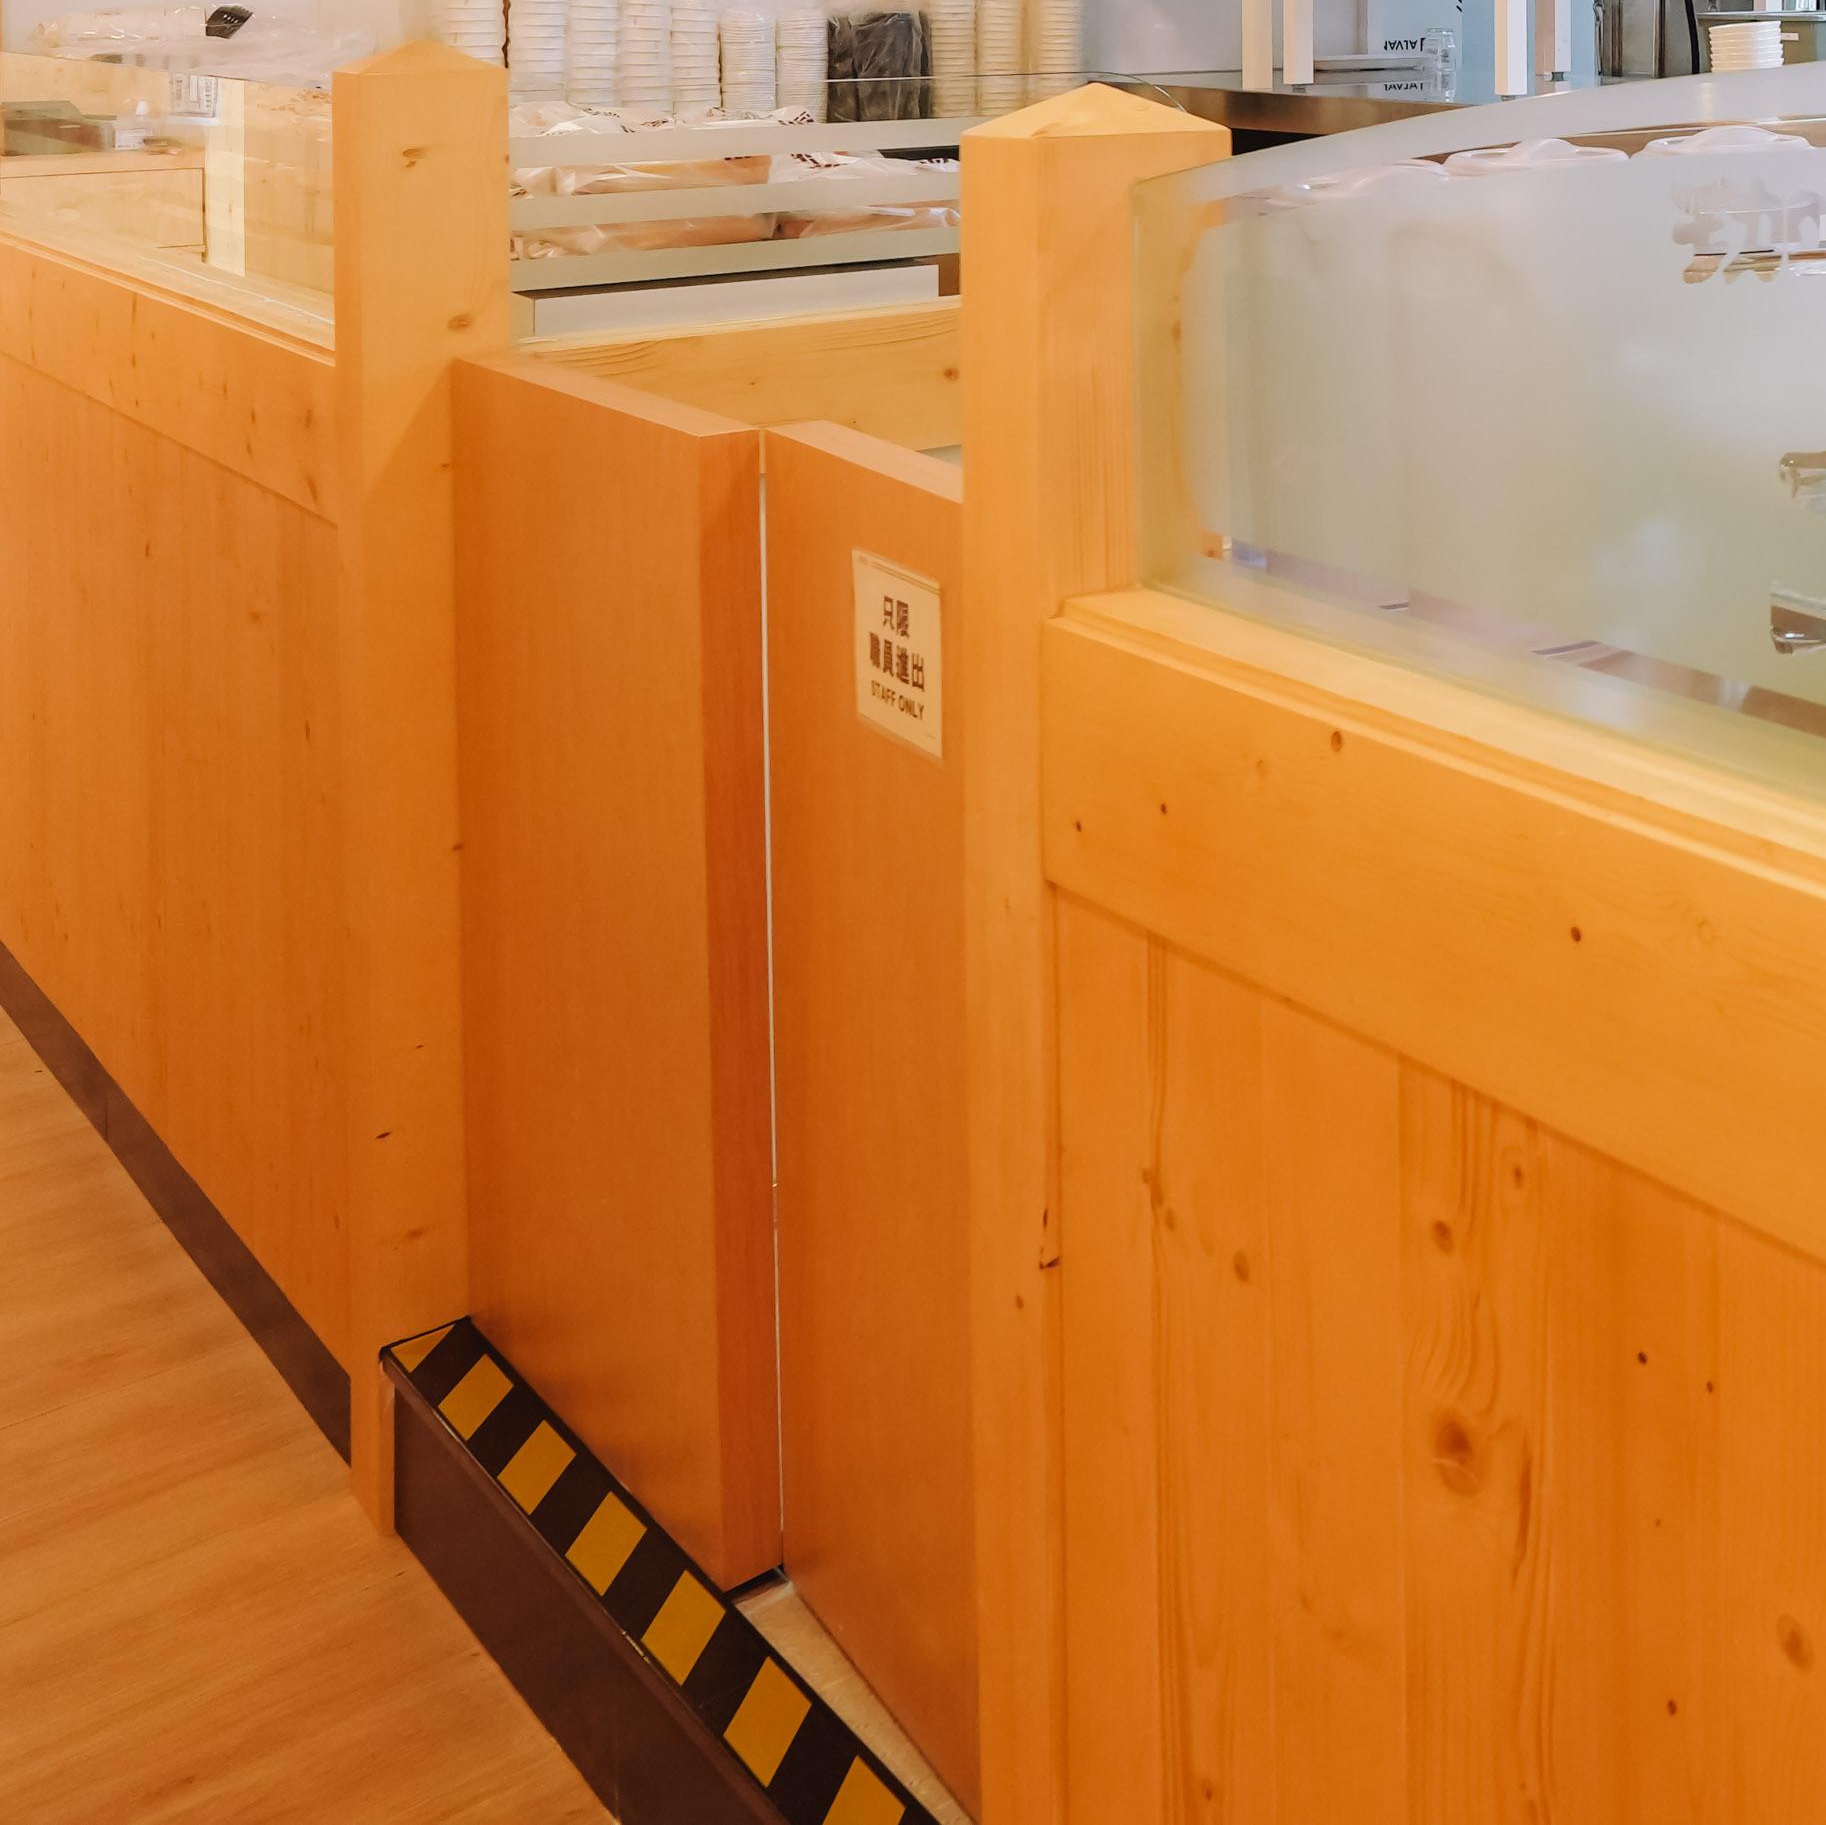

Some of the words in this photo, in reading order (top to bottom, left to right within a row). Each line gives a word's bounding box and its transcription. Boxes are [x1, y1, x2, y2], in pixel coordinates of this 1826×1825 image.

[882, 595, 910, 639] 只限
[871, 679, 896, 708] STAFF
[898, 694, 925, 721] ONLY
